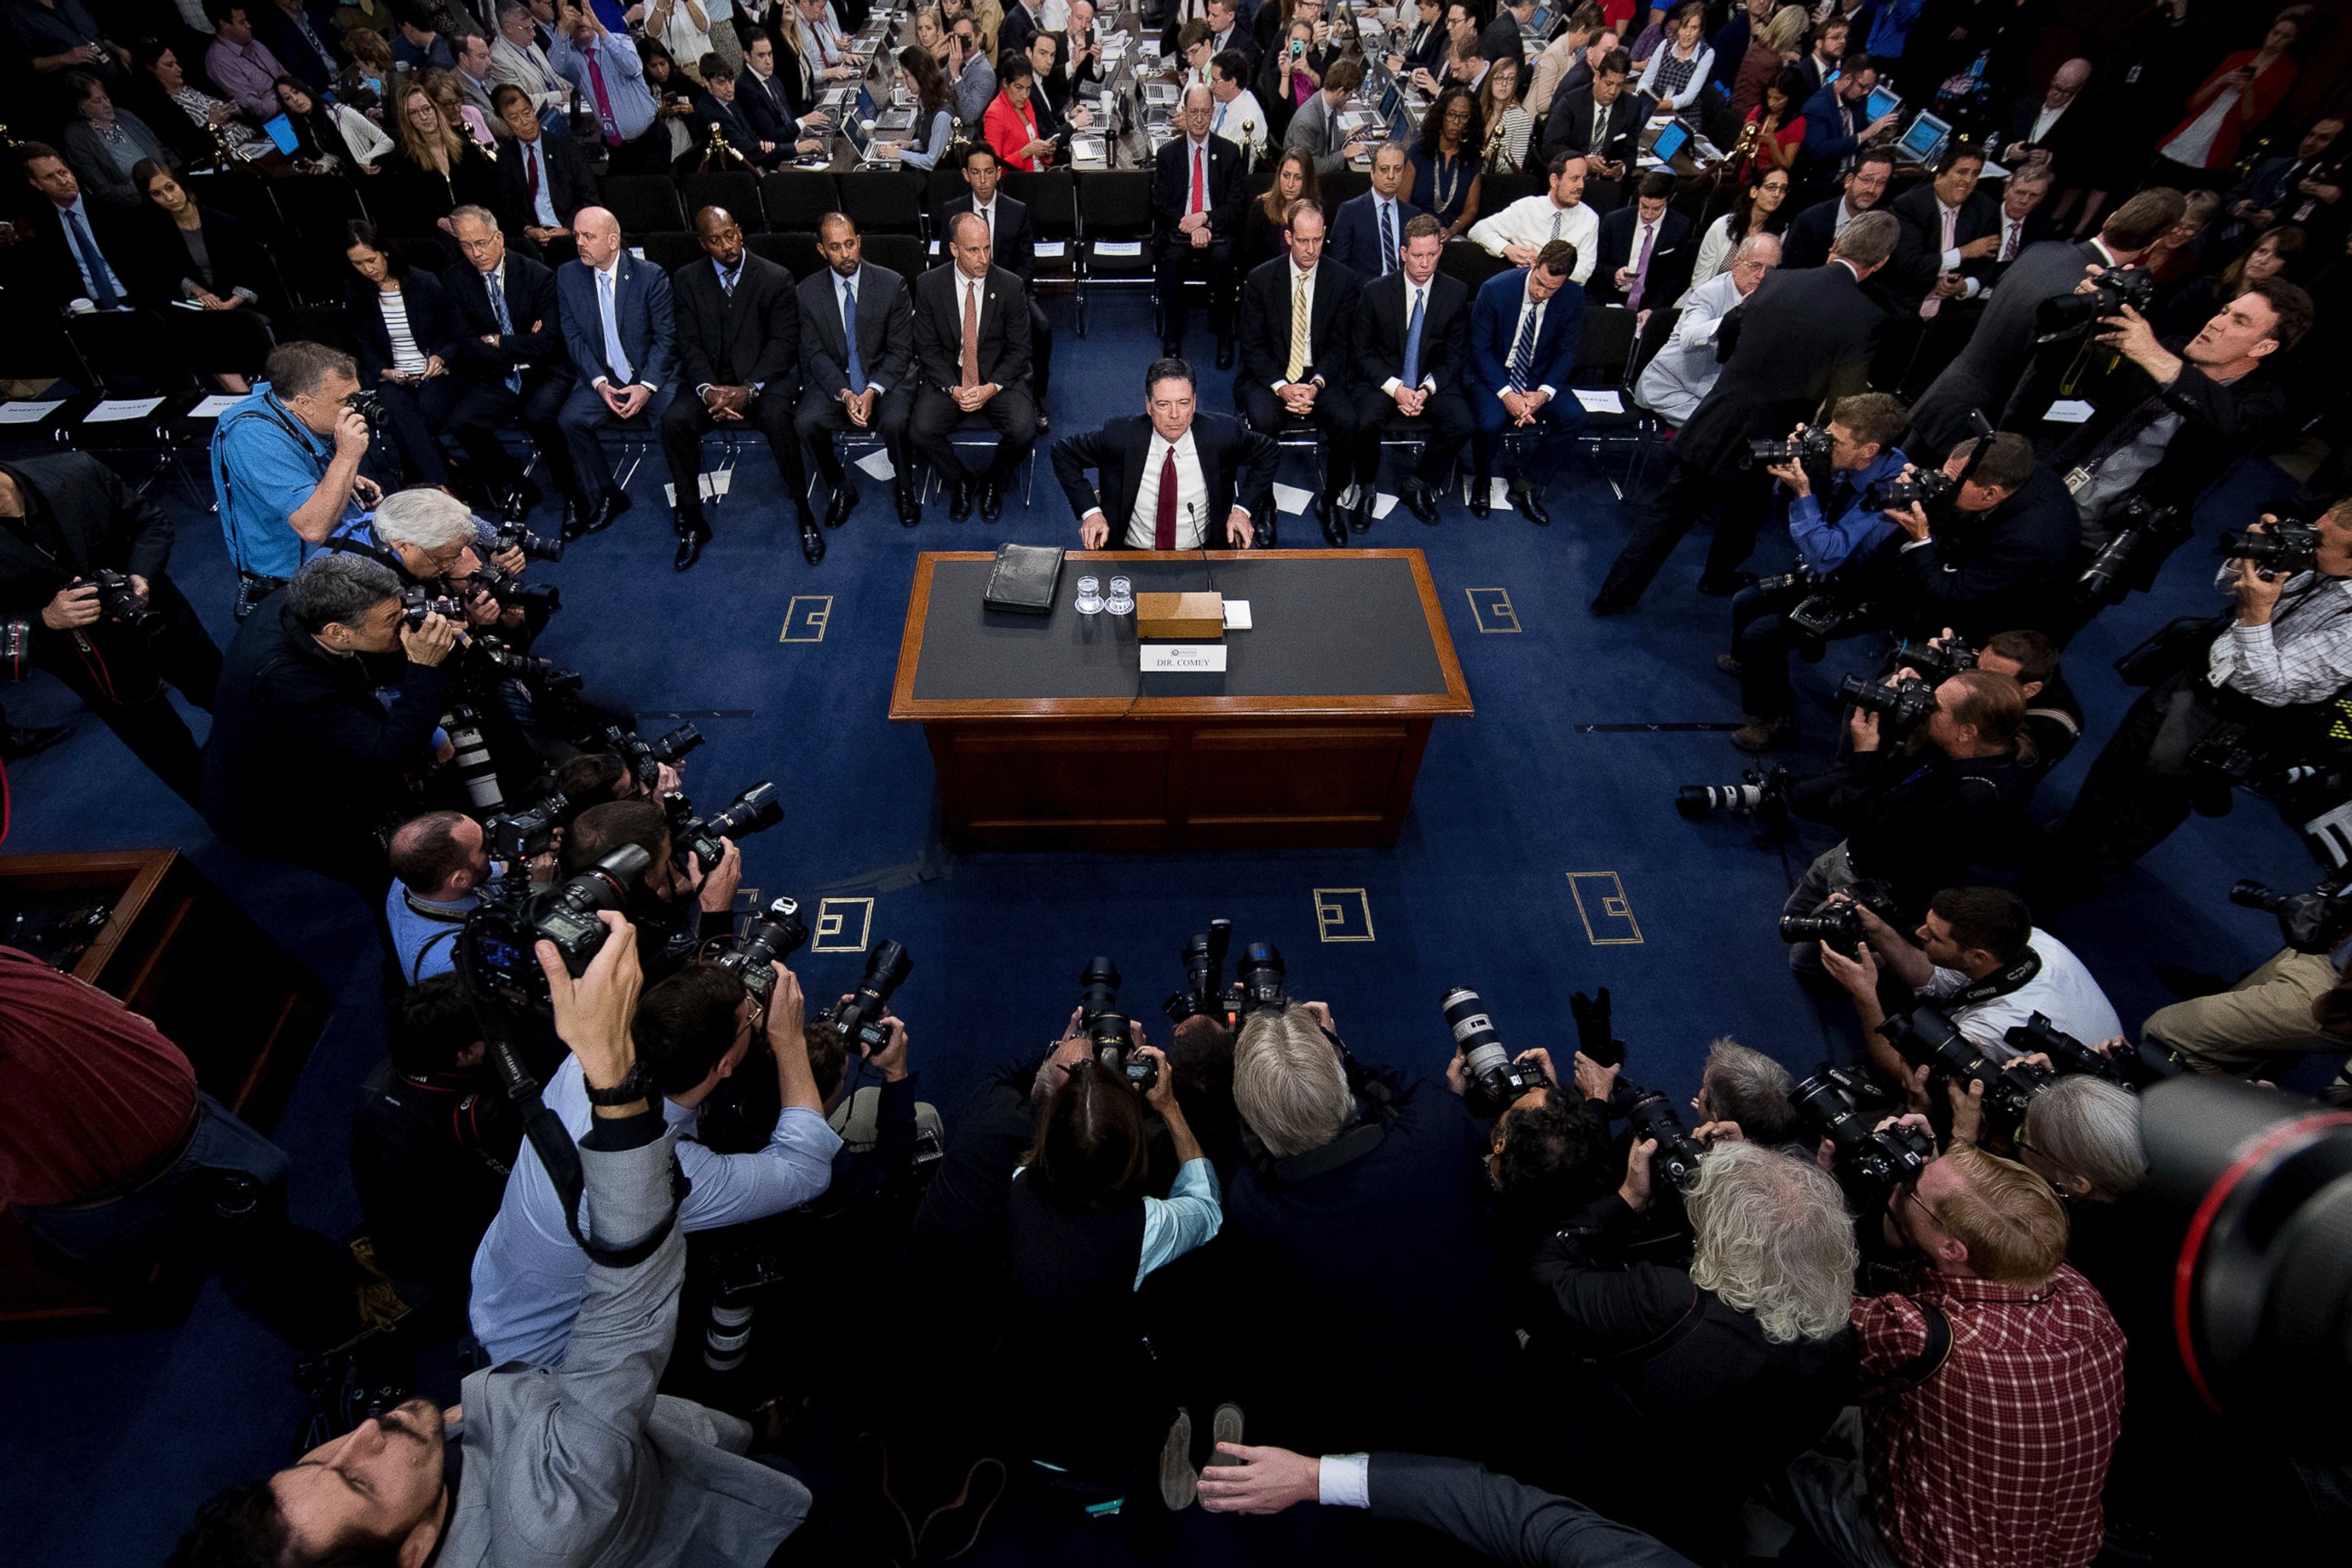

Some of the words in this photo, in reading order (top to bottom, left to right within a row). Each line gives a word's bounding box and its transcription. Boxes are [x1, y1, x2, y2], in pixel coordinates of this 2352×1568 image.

[1156, 659, 1175, 667] DIR.
[1177, 659, 1210, 667] COMEY
[1966, 985, 1997, 999] Canon
[1828, 1069, 1852, 1086] Canon
